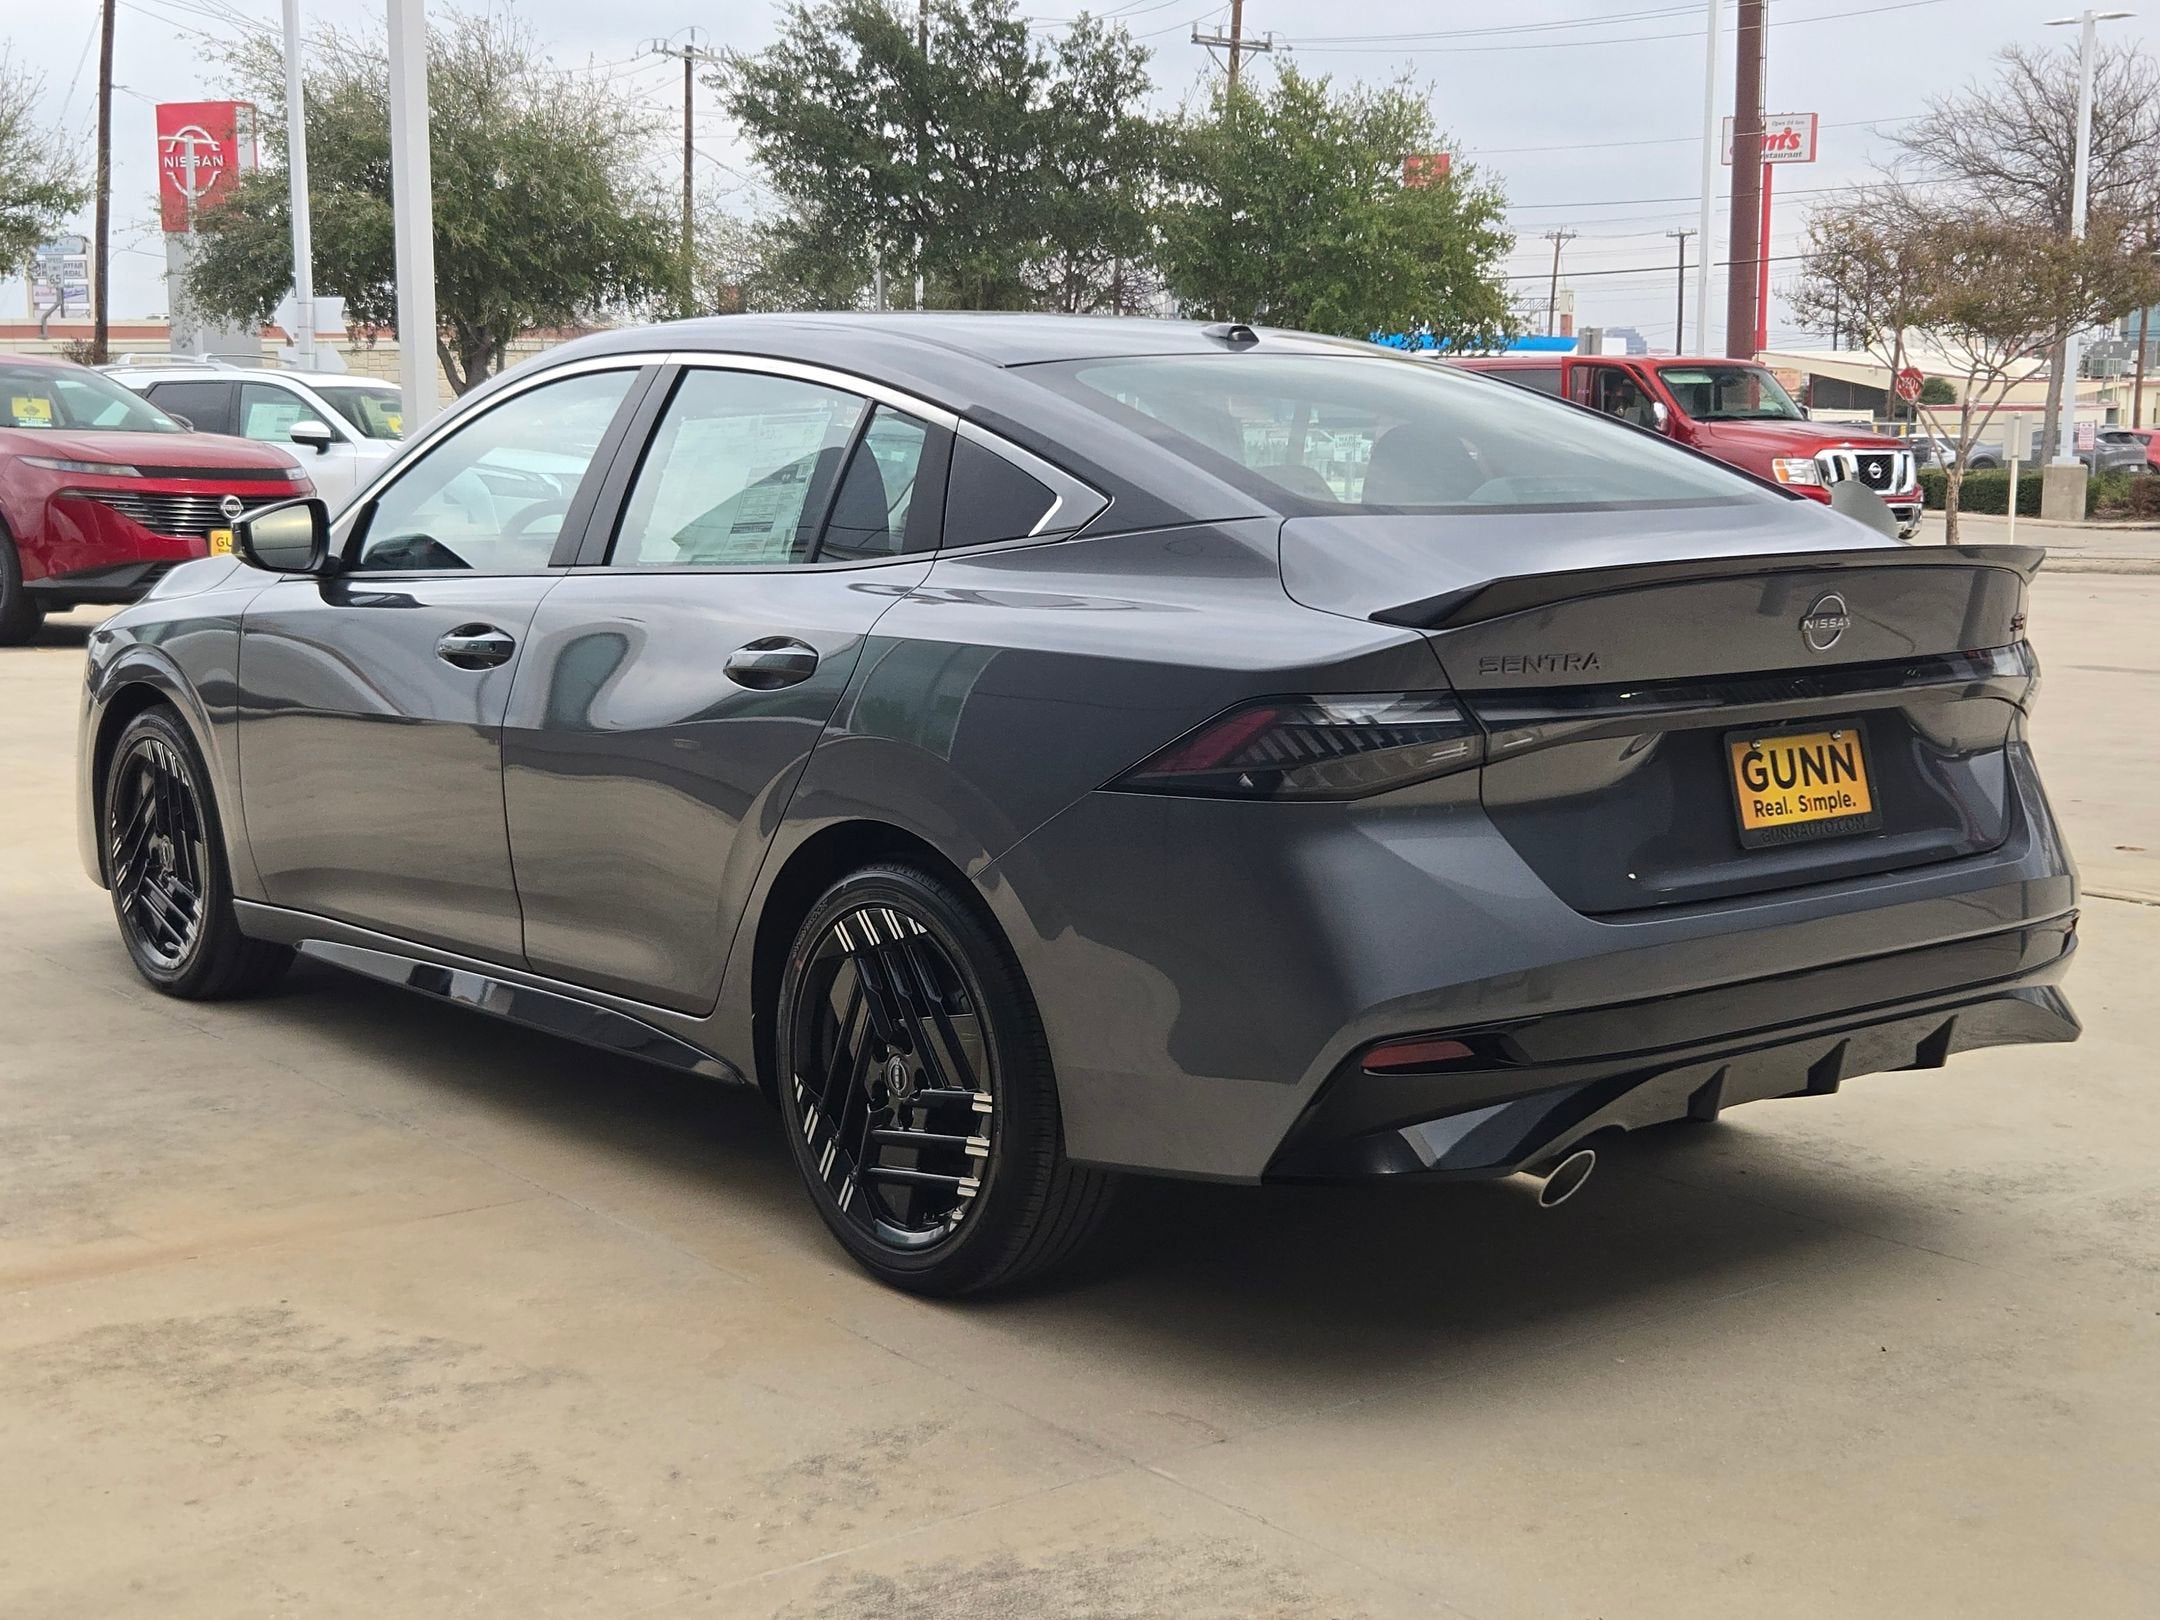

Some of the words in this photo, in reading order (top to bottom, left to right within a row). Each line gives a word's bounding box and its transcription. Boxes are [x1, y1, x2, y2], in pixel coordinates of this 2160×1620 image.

[164, 155, 224, 168] NISSAN
[49, 274, 62, 285] 65
[216, 536, 232, 548] GU
[1479, 652, 1600, 676] SENTRA
[1741, 743, 1858, 793] GUNN
[1753, 796, 1793, 818] Real.
